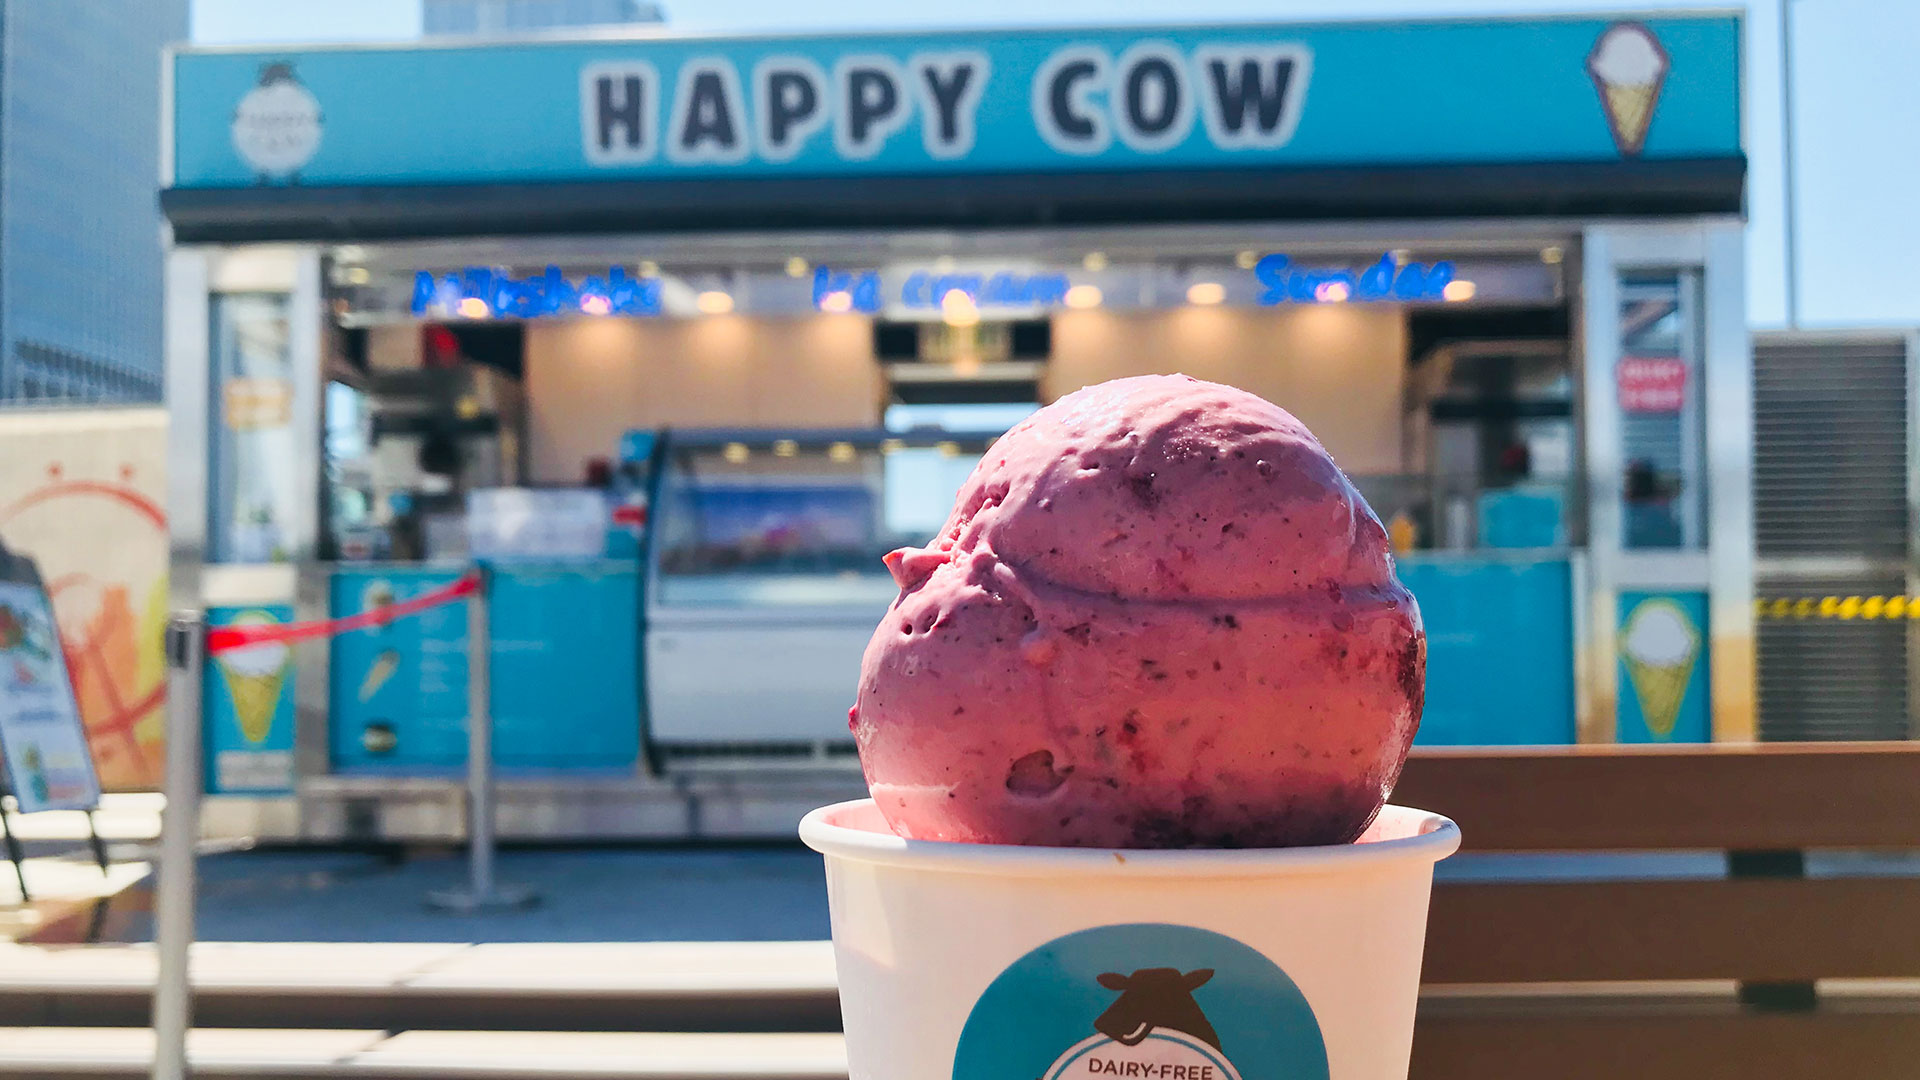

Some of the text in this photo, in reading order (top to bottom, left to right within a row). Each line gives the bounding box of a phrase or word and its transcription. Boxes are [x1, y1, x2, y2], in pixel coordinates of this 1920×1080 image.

[588, 51, 1303, 158] HAPPY COW
[1088, 1057, 1214, 1080] DAIRY-FREE
